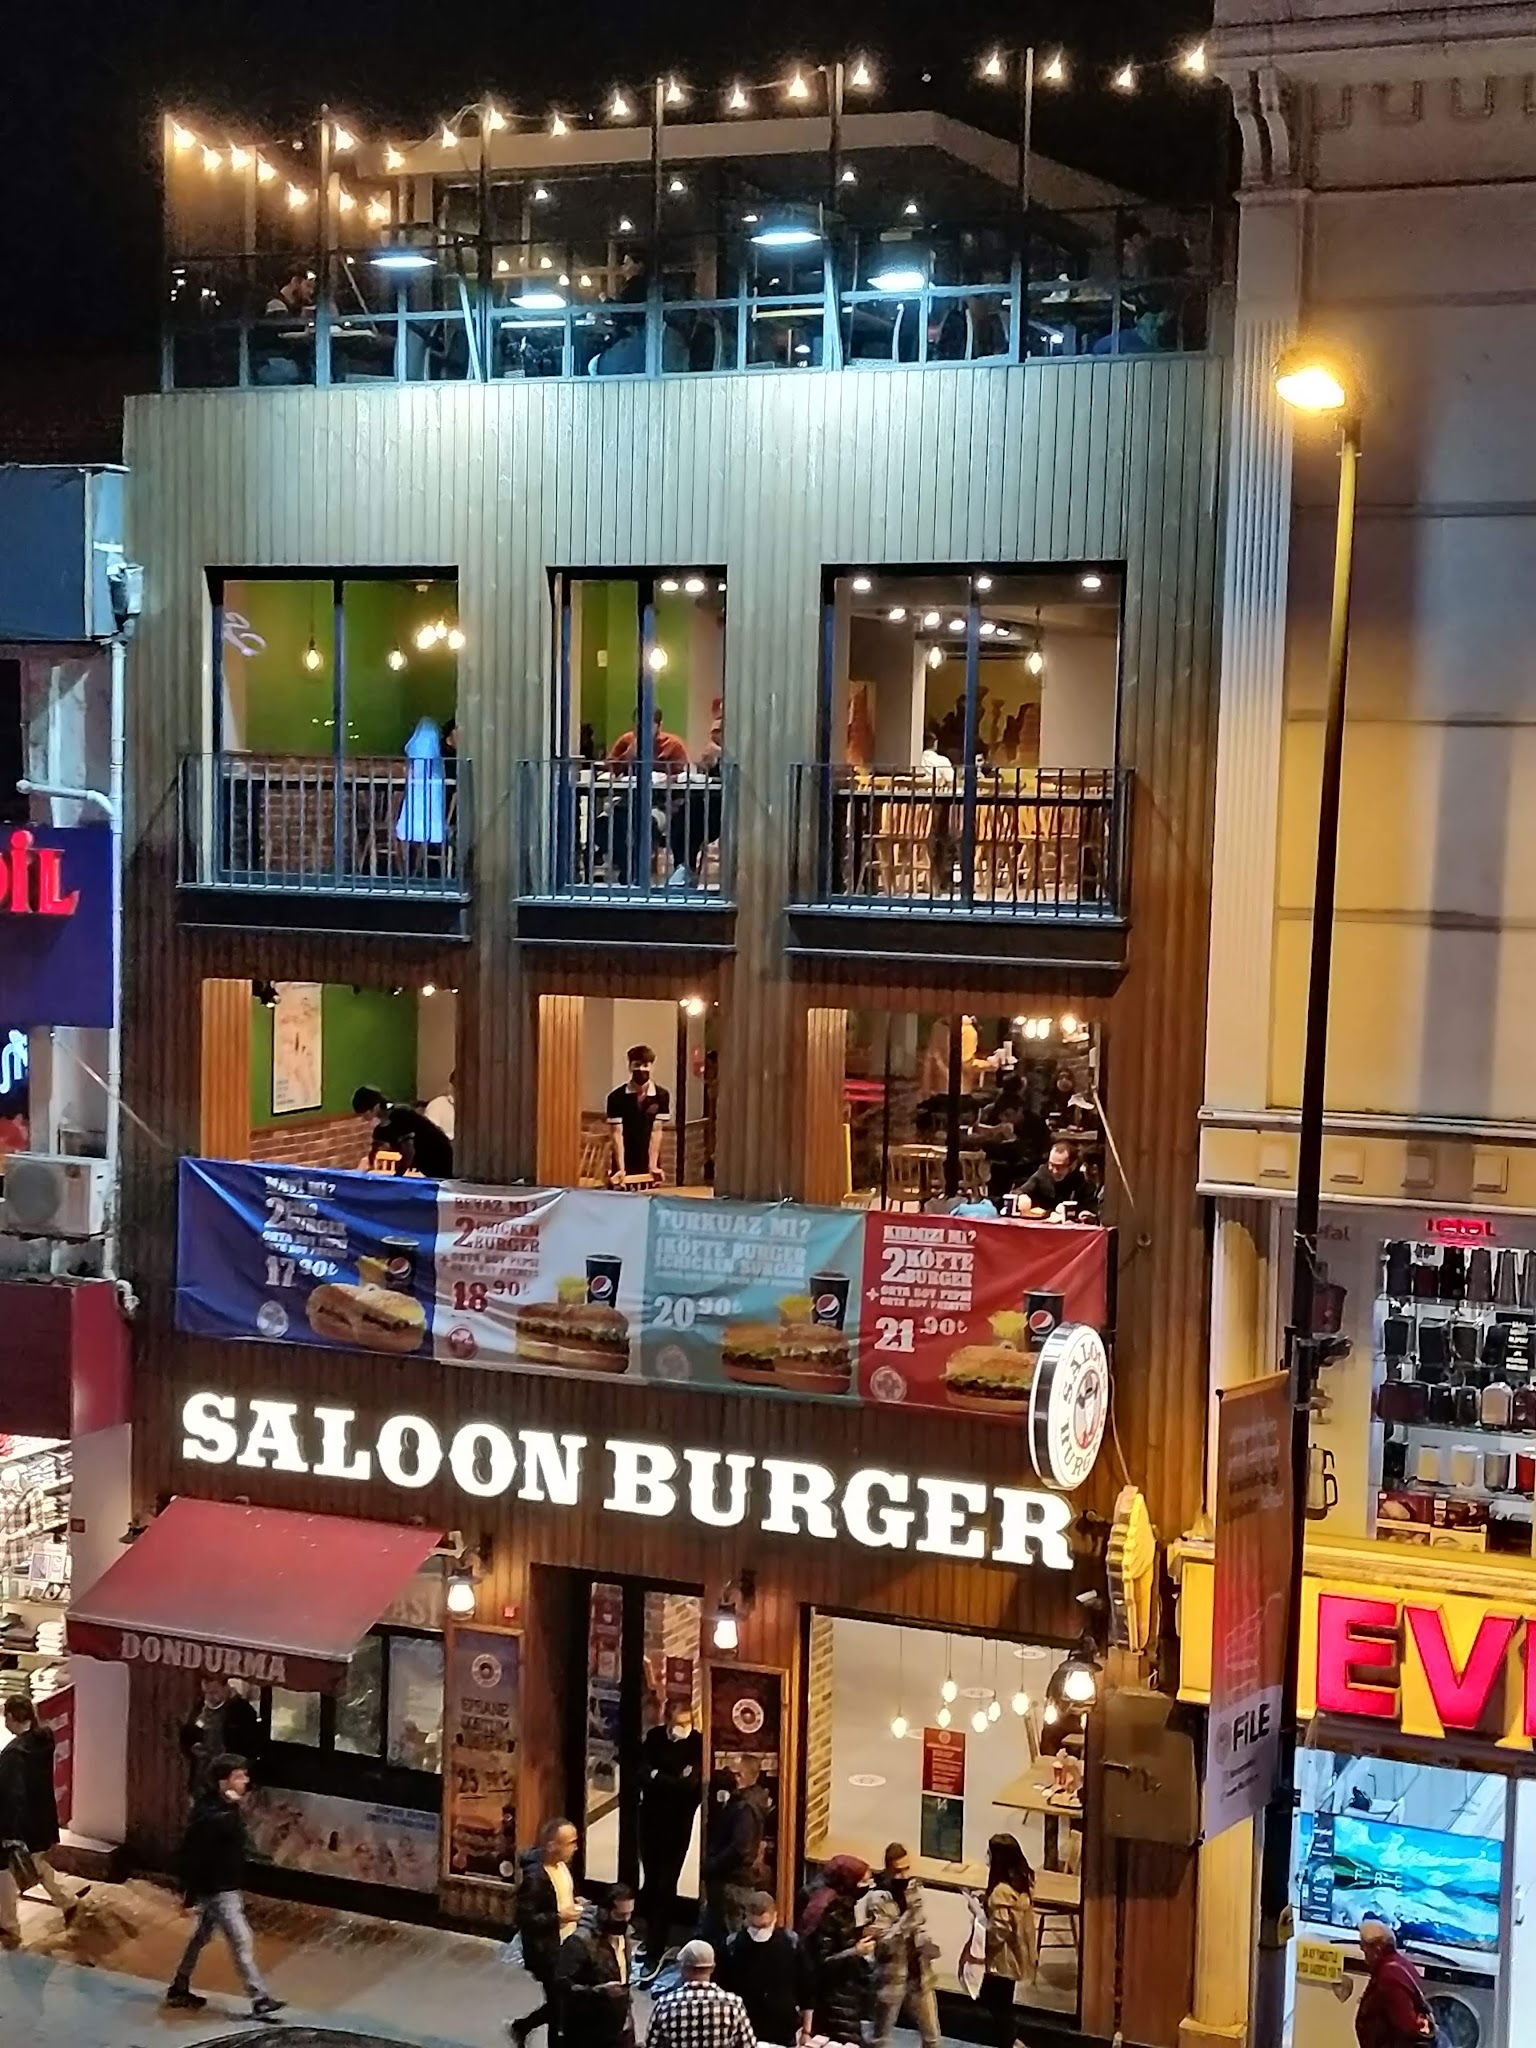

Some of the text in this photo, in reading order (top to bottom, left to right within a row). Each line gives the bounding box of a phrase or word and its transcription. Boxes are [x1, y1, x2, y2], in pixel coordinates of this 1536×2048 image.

[0, 830, 80, 915] İL
[453, 1216, 476, 1249] 2
[656, 1209, 812, 1240] TURKUAZ MI?
[474, 1236, 540, 1253] BURGER
[905, 1247, 974, 1271] KÖFTE
[265, 1256, 296, 1287] 17
[881, 1247, 907, 1283] 2
[904, 1269, 972, 1288] BURGER
[453, 1281, 488, 1313] 18
[652, 1295, 696, 1332] 20
[874, 1317, 916, 1352] 21
[182, 1391, 1075, 1570] SALOON BURGER
[121, 1631, 287, 1684] DONDURMA
